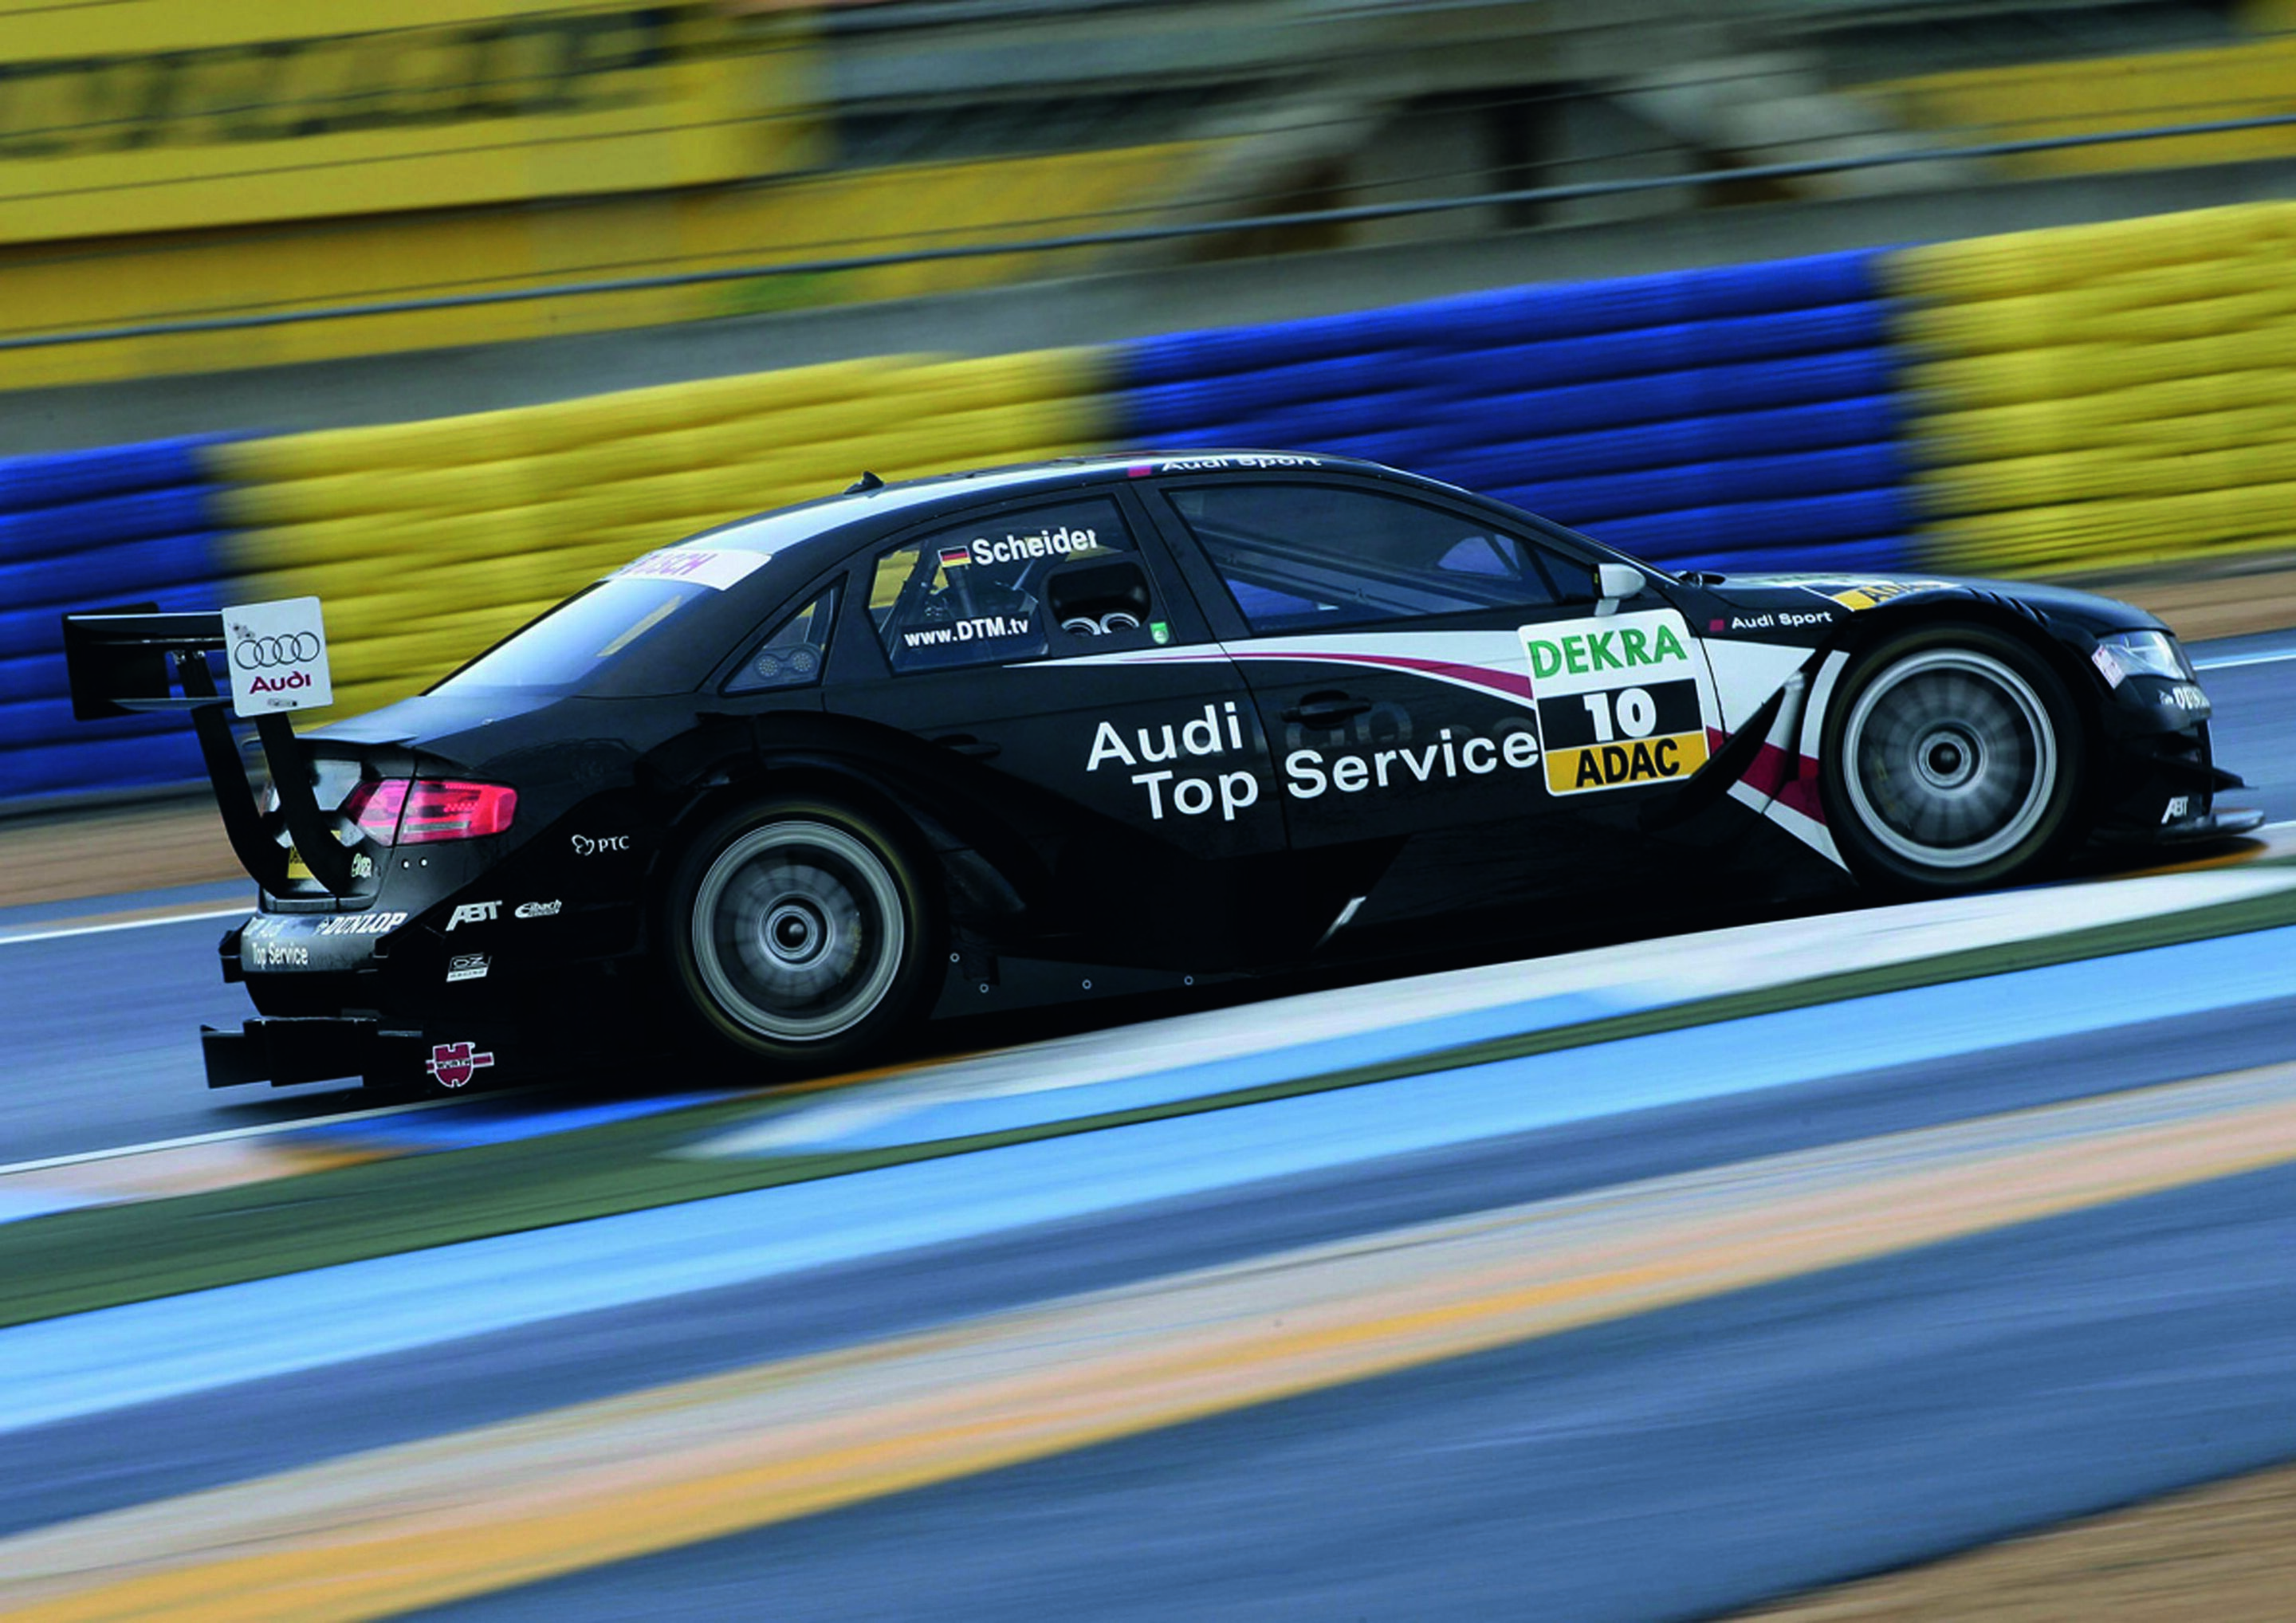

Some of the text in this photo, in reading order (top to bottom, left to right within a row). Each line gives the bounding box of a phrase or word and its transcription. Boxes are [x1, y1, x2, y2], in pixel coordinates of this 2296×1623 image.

[1162, 458, 1229, 472] Audi
[972, 526, 1098, 565] Scheider
[904, 616, 1029, 647] www.DTM.tv
[1732, 611, 1833, 630] Audi Sport
[1527, 624, 1688, 679] DEKRA
[249, 670, 312, 695] Audi
[1582, 687, 1657, 742] 10
[1086, 701, 1244, 772] Audi
[1131, 728, 1539, 821] Top Service
[1575, 738, 1681, 788] ADAC
[320, 912, 408, 936] DUNLOP
[445, 900, 503, 931] ABT
[269, 942, 309, 965] Service
